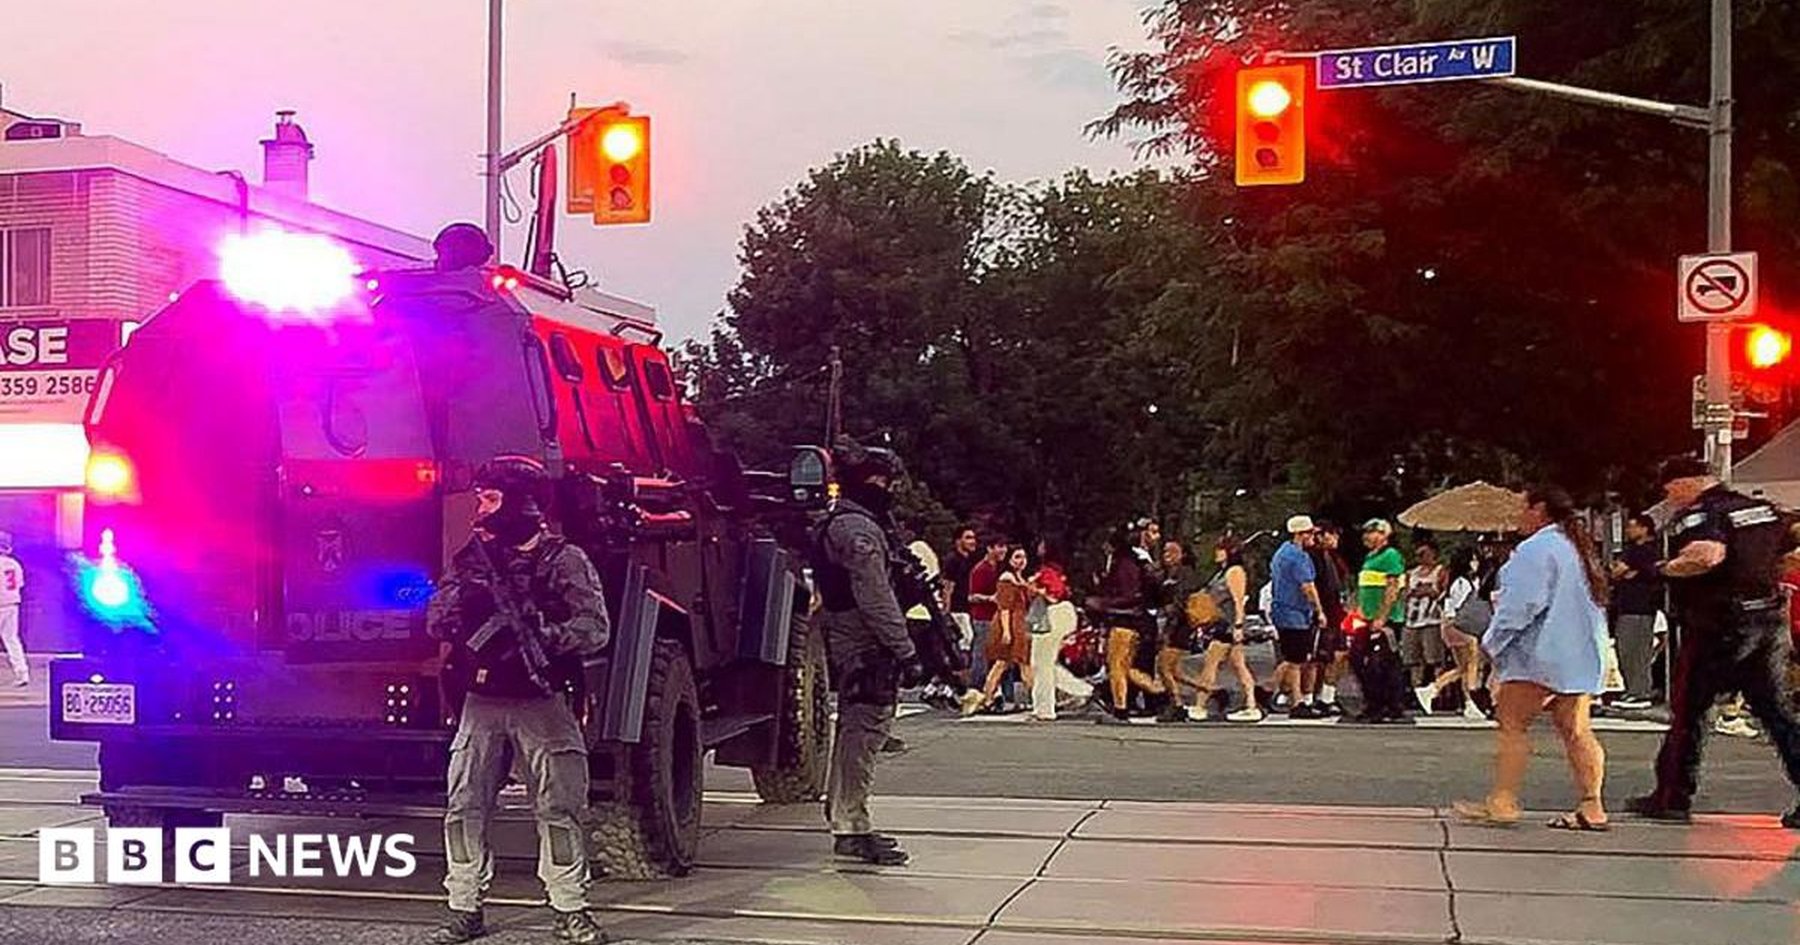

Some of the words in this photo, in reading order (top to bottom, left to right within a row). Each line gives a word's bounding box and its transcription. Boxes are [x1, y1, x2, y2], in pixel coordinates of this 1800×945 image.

[1335, 55, 1363, 80] St
[1373, 50, 1439, 77] Clair
[1471, 44, 1497, 69] W
[0, 327, 69, 365] SE
[1, 376, 38, 396] 359
[46, 375, 95, 395] 2586
[286, 611, 411, 640] OLICE
